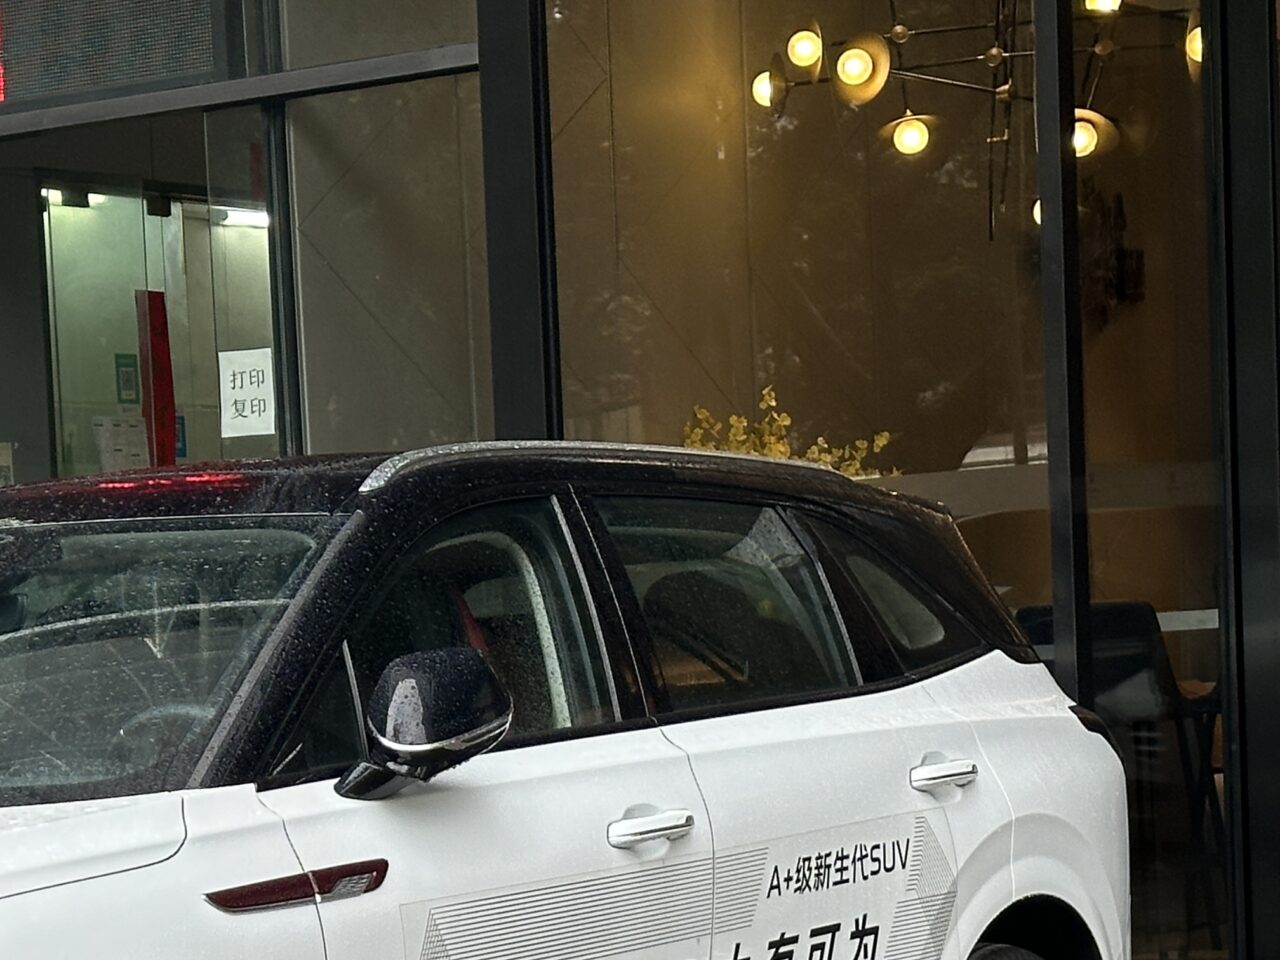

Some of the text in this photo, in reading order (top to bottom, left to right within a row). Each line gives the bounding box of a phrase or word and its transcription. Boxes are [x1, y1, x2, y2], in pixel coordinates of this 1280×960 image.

[230, 368, 265, 390] 打印
[231, 397, 267, 420] 复印
[766, 838, 911, 899] A+级新生代SUV
